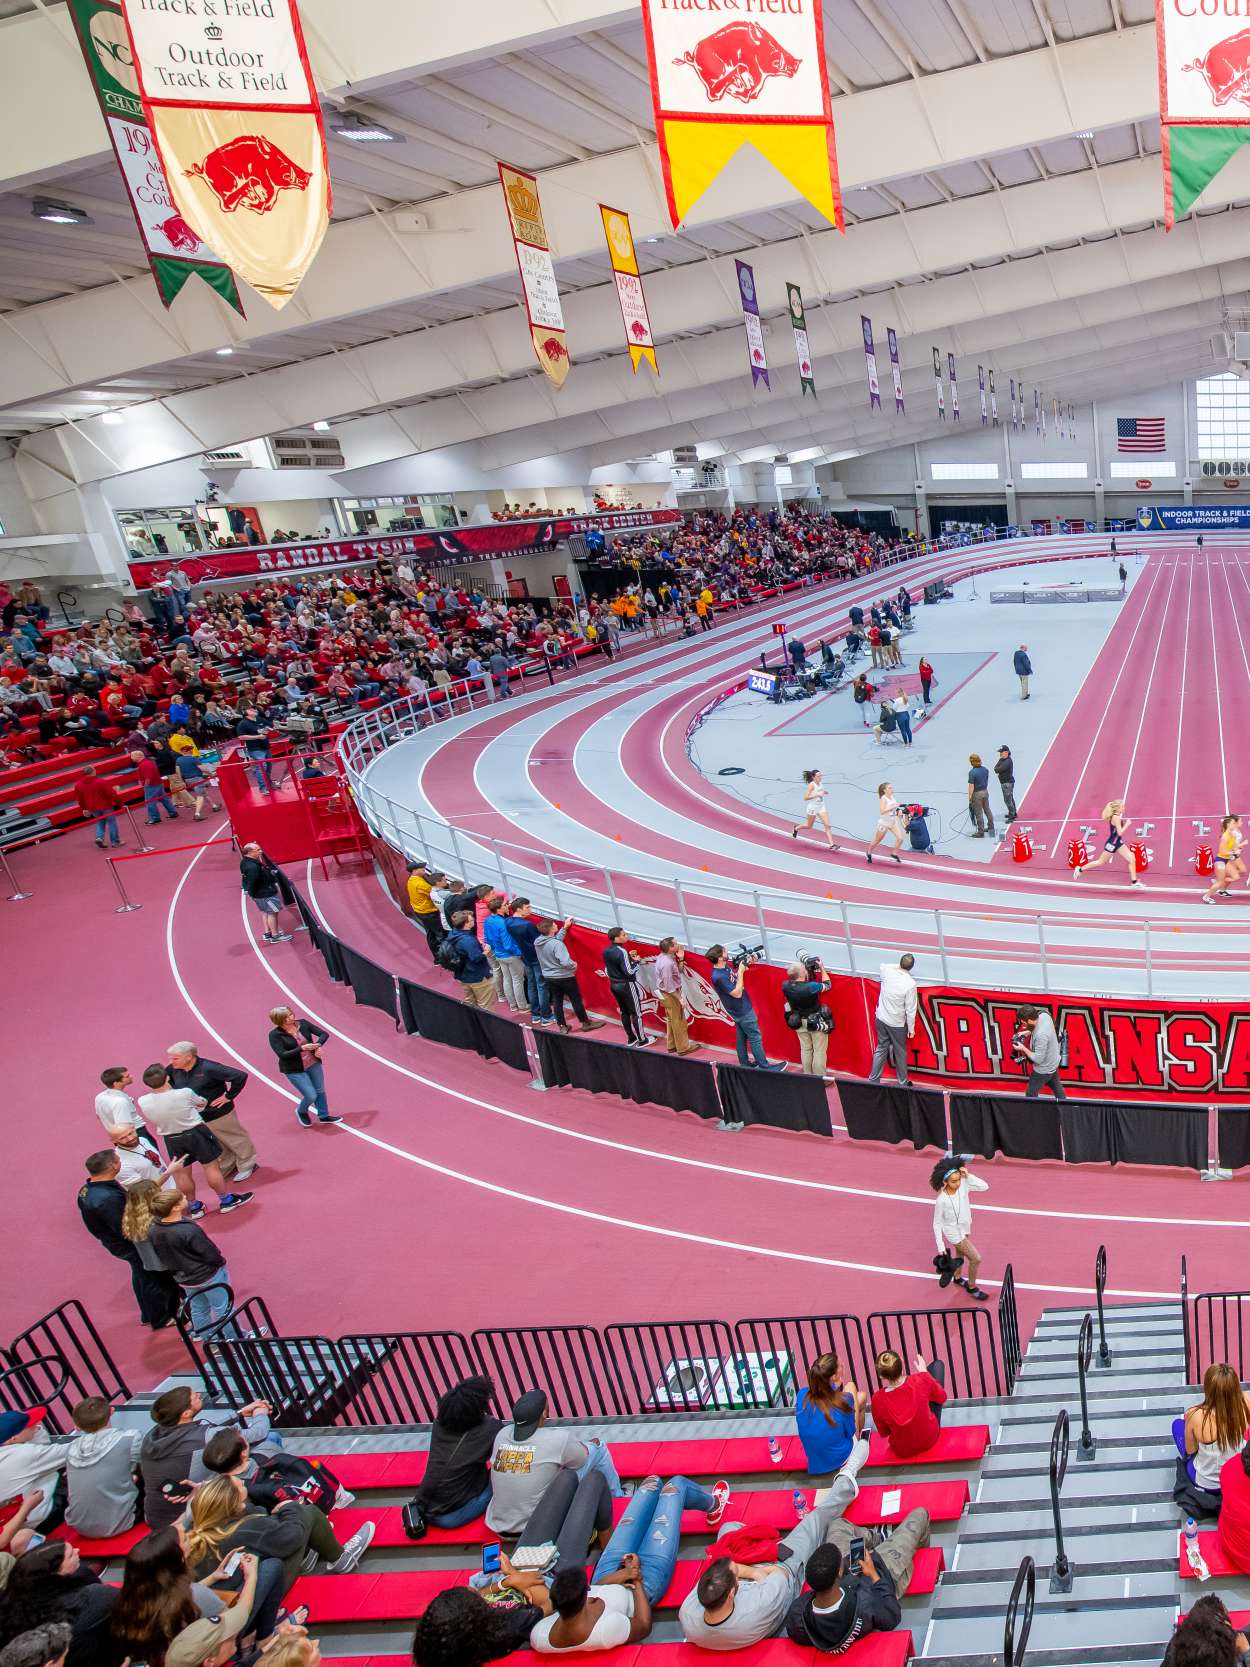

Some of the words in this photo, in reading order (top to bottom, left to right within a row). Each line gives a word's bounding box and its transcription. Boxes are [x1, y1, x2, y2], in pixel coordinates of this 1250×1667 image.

[168, 43, 264, 68] Outdoor
[154, 66, 210, 88] Track
[218, 71, 234, 89] &
[242, 72, 288, 91] Field
[613, 513, 654, 528] CENTER
[1175, 516, 1239, 524] CHAMPIONSHIPS
[256, 545, 349, 571] RANDAL
[352, 537, 416, 559] TYSON
[1023, 841, 1029, 857] 1
[1079, 848, 1086, 864] 2
[1140, 850, 1148, 866] 3
[1206, 854, 1214, 869] 4
